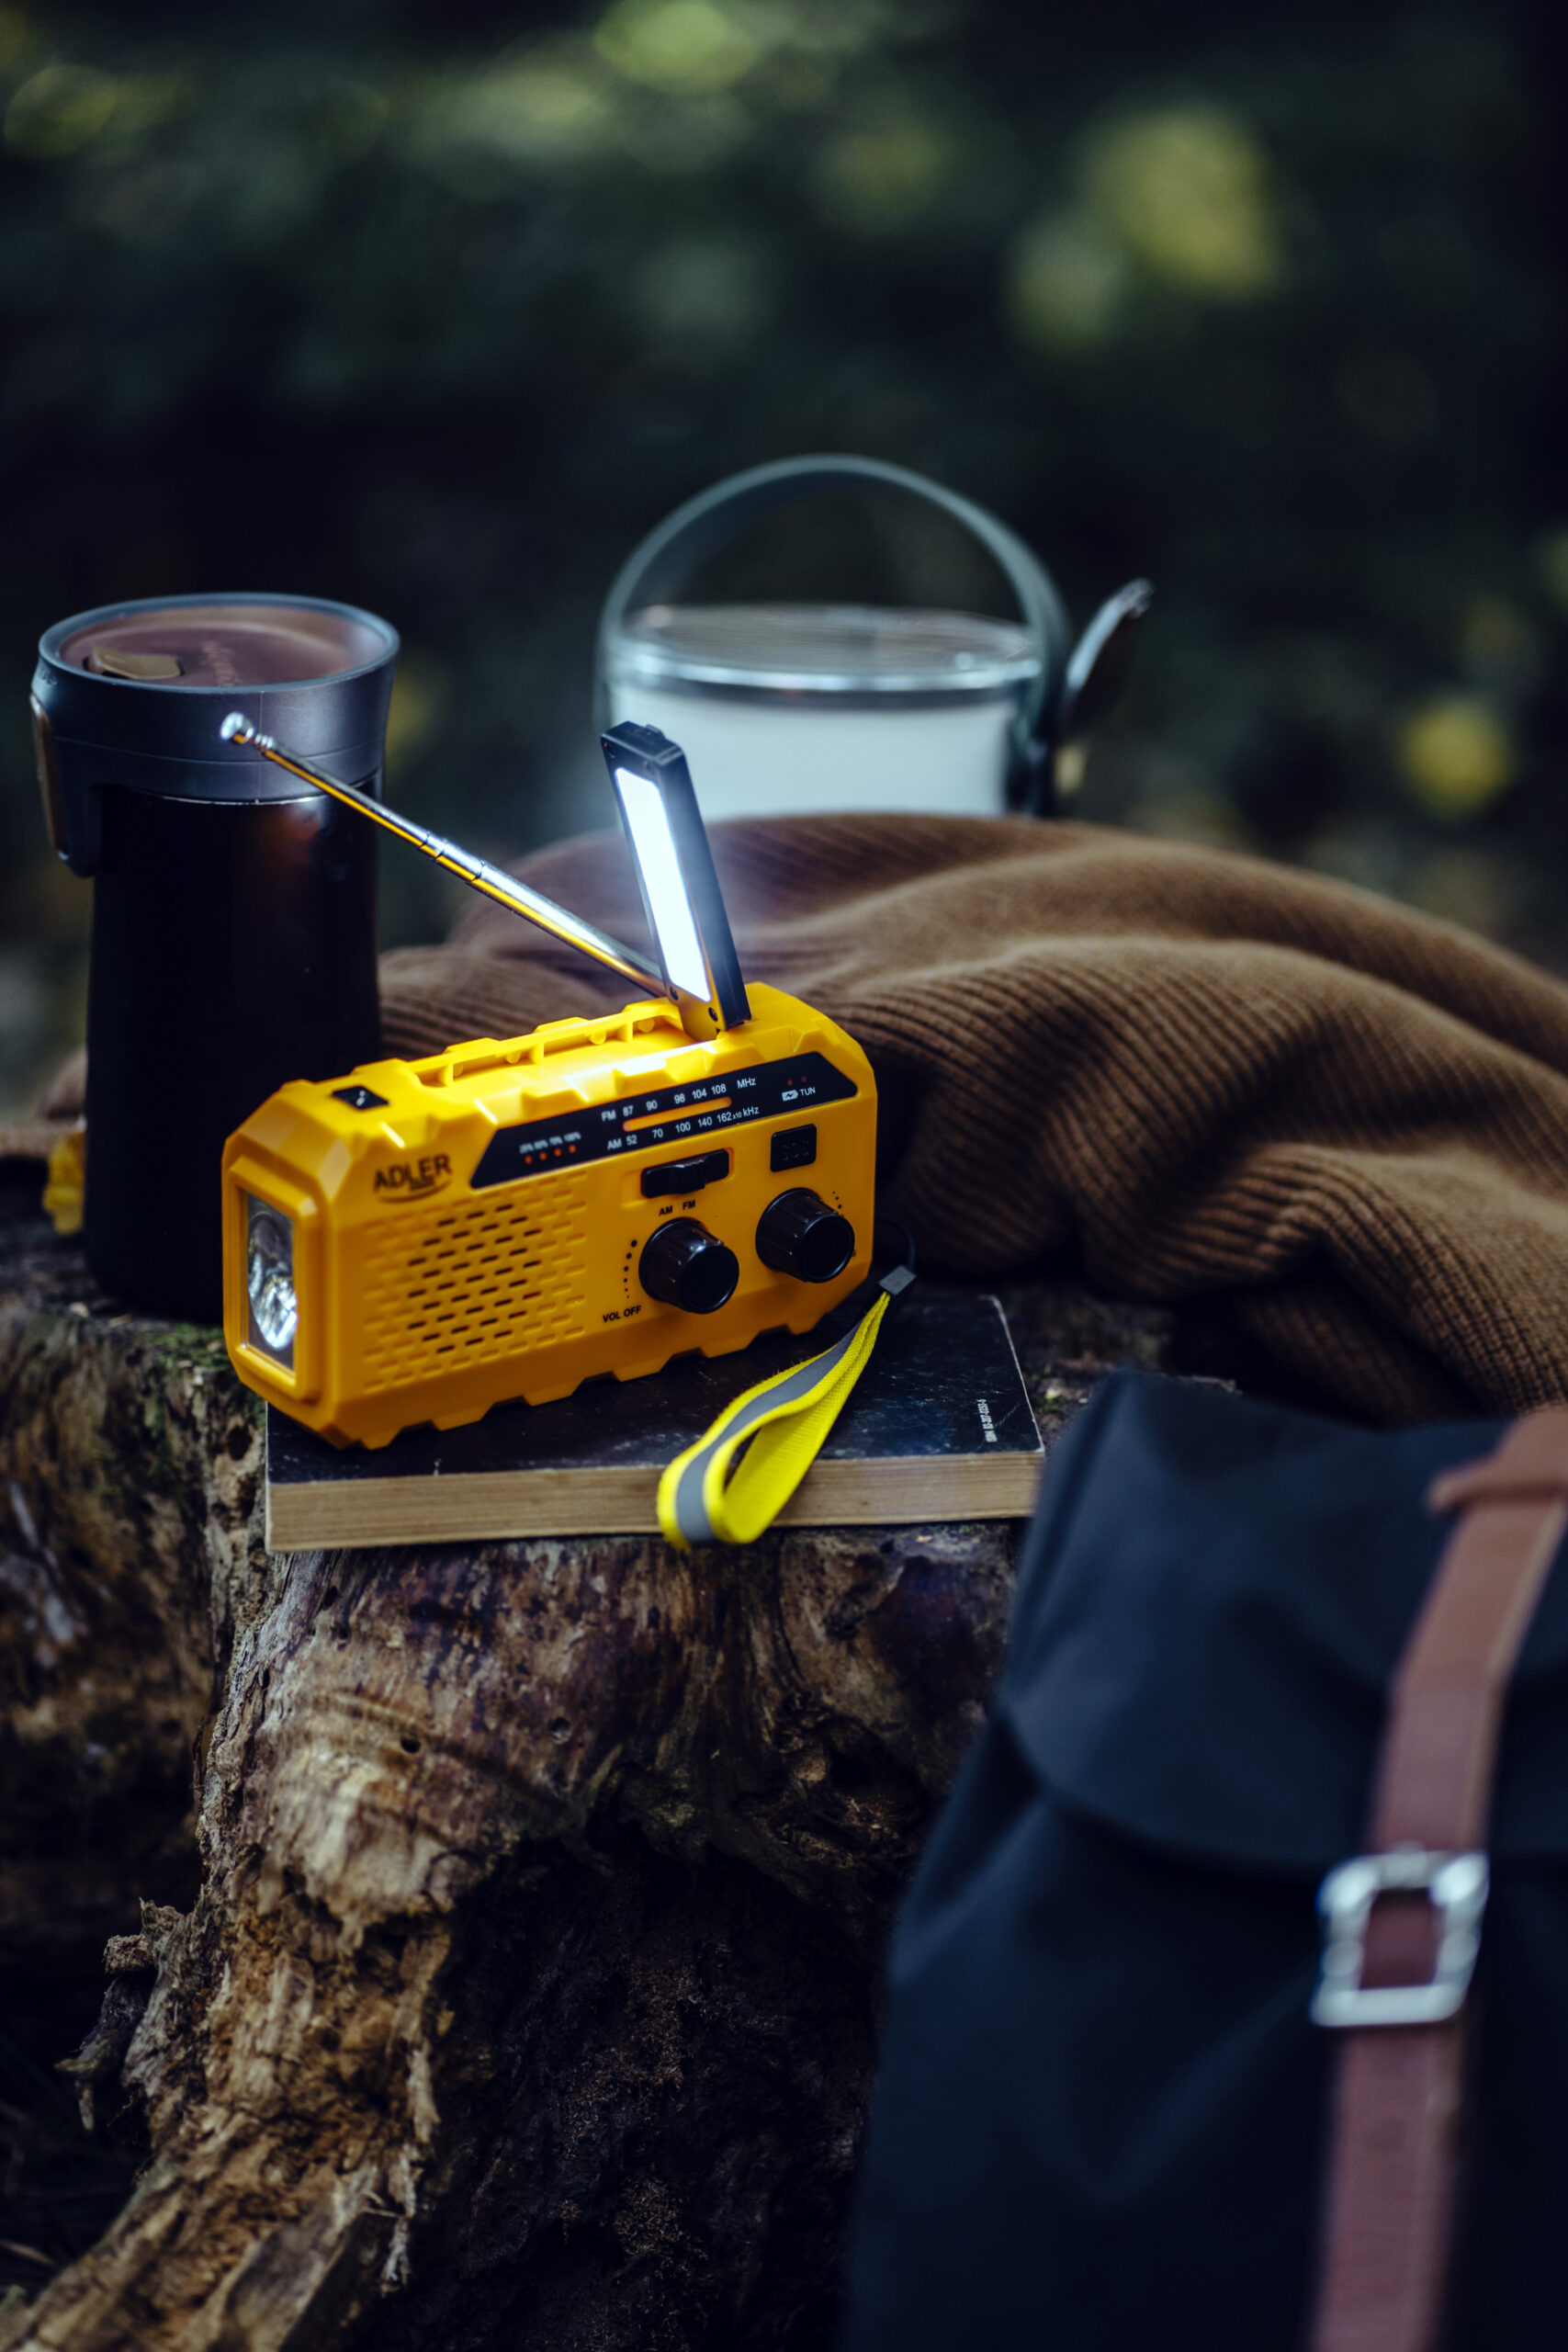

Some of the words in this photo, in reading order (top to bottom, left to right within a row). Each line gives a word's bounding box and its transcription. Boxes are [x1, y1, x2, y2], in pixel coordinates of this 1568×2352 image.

[601, 1109, 616, 1122] FM
[622, 1105, 634, 1116] 87
[646, 1100, 658, 1111] 90
[673, 1093, 685, 1104] 98
[692, 1088, 707, 1100] 104
[711, 1083, 727, 1095] 108
[737, 1078, 757, 1090] MHz
[800, 1087, 816, 1097] TUN
[607, 1138, 622, 1150] AM
[626, 1135, 637, 1146] 52
[651, 1128, 663, 1138] 70
[675, 1122, 691, 1133] 100
[697, 1116, 712, 1127] 140
[716, 1112, 732, 1123] 162
[742, 1105, 760, 1117] kHz
[373, 1154, 451, 1193] ADLER
[659, 1205, 673, 1216] AM
[682, 1199, 695, 1210] FM
[603, 1311, 621, 1323] VOL
[624, 1305, 642, 1317] OFF
